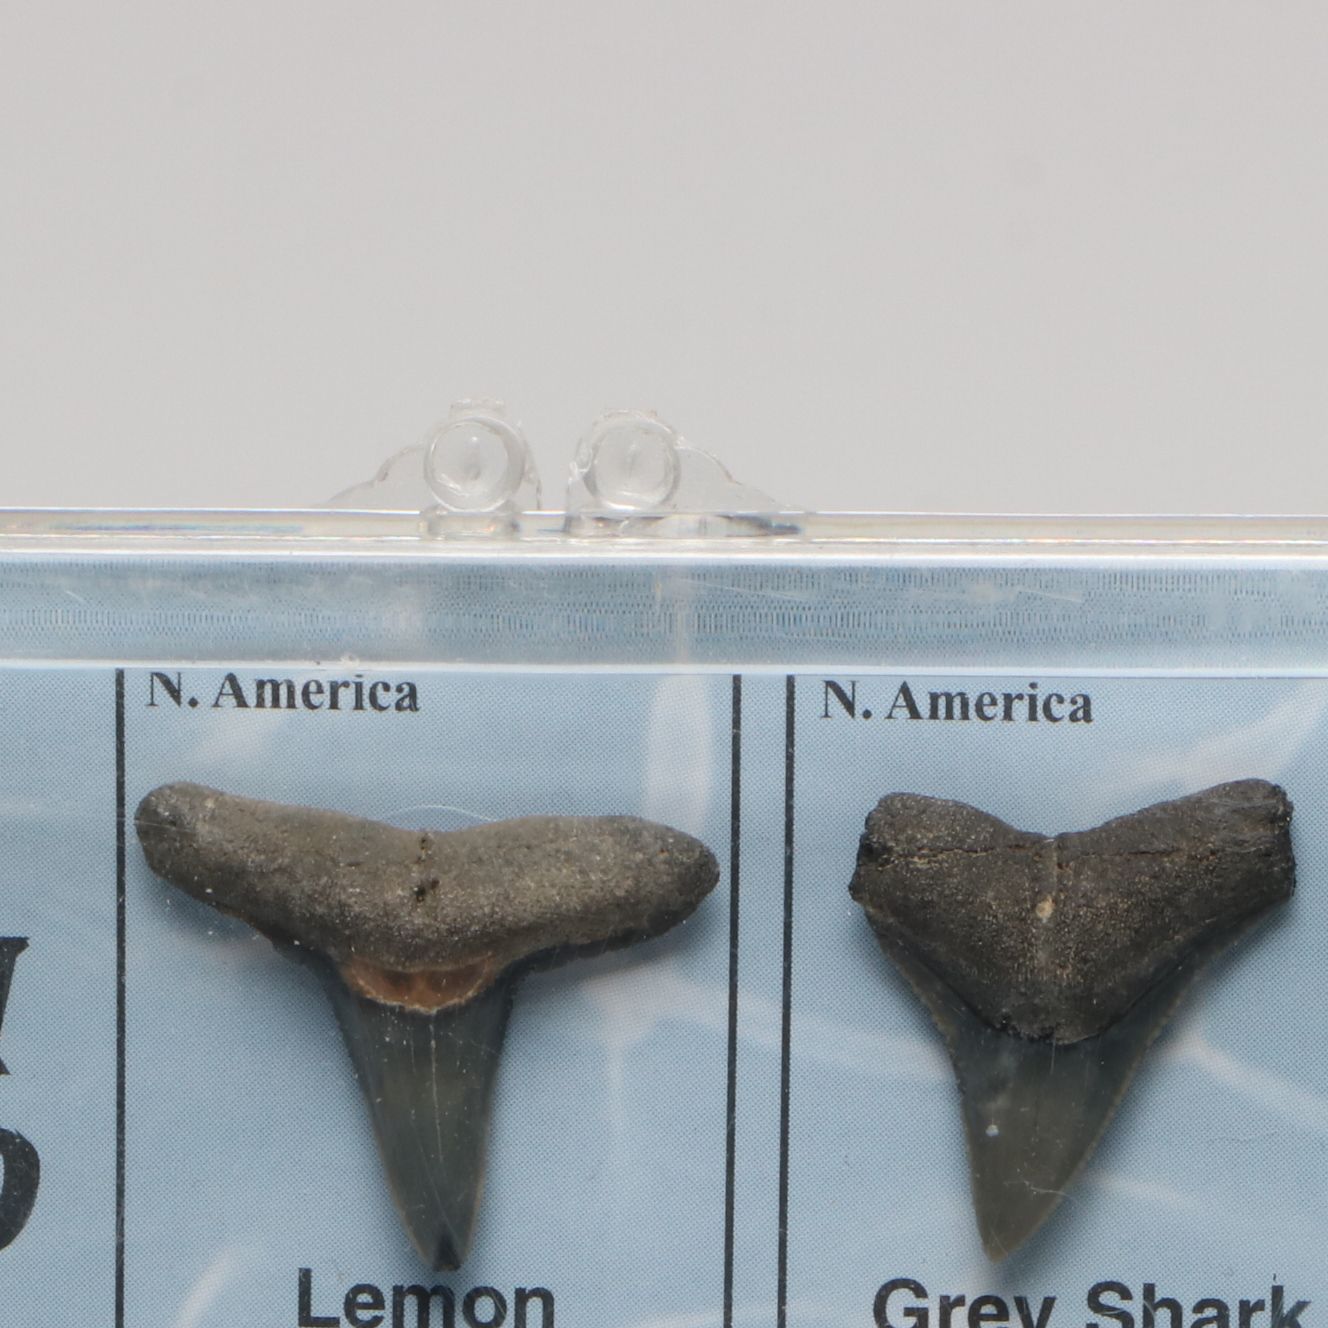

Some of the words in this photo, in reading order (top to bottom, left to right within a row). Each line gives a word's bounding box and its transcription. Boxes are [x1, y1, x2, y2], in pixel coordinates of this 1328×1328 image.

[146, 671, 199, 709] N.
[211, 671, 421, 713] America
[820, 679, 873, 720] N.
[885, 681, 1094, 724] America
